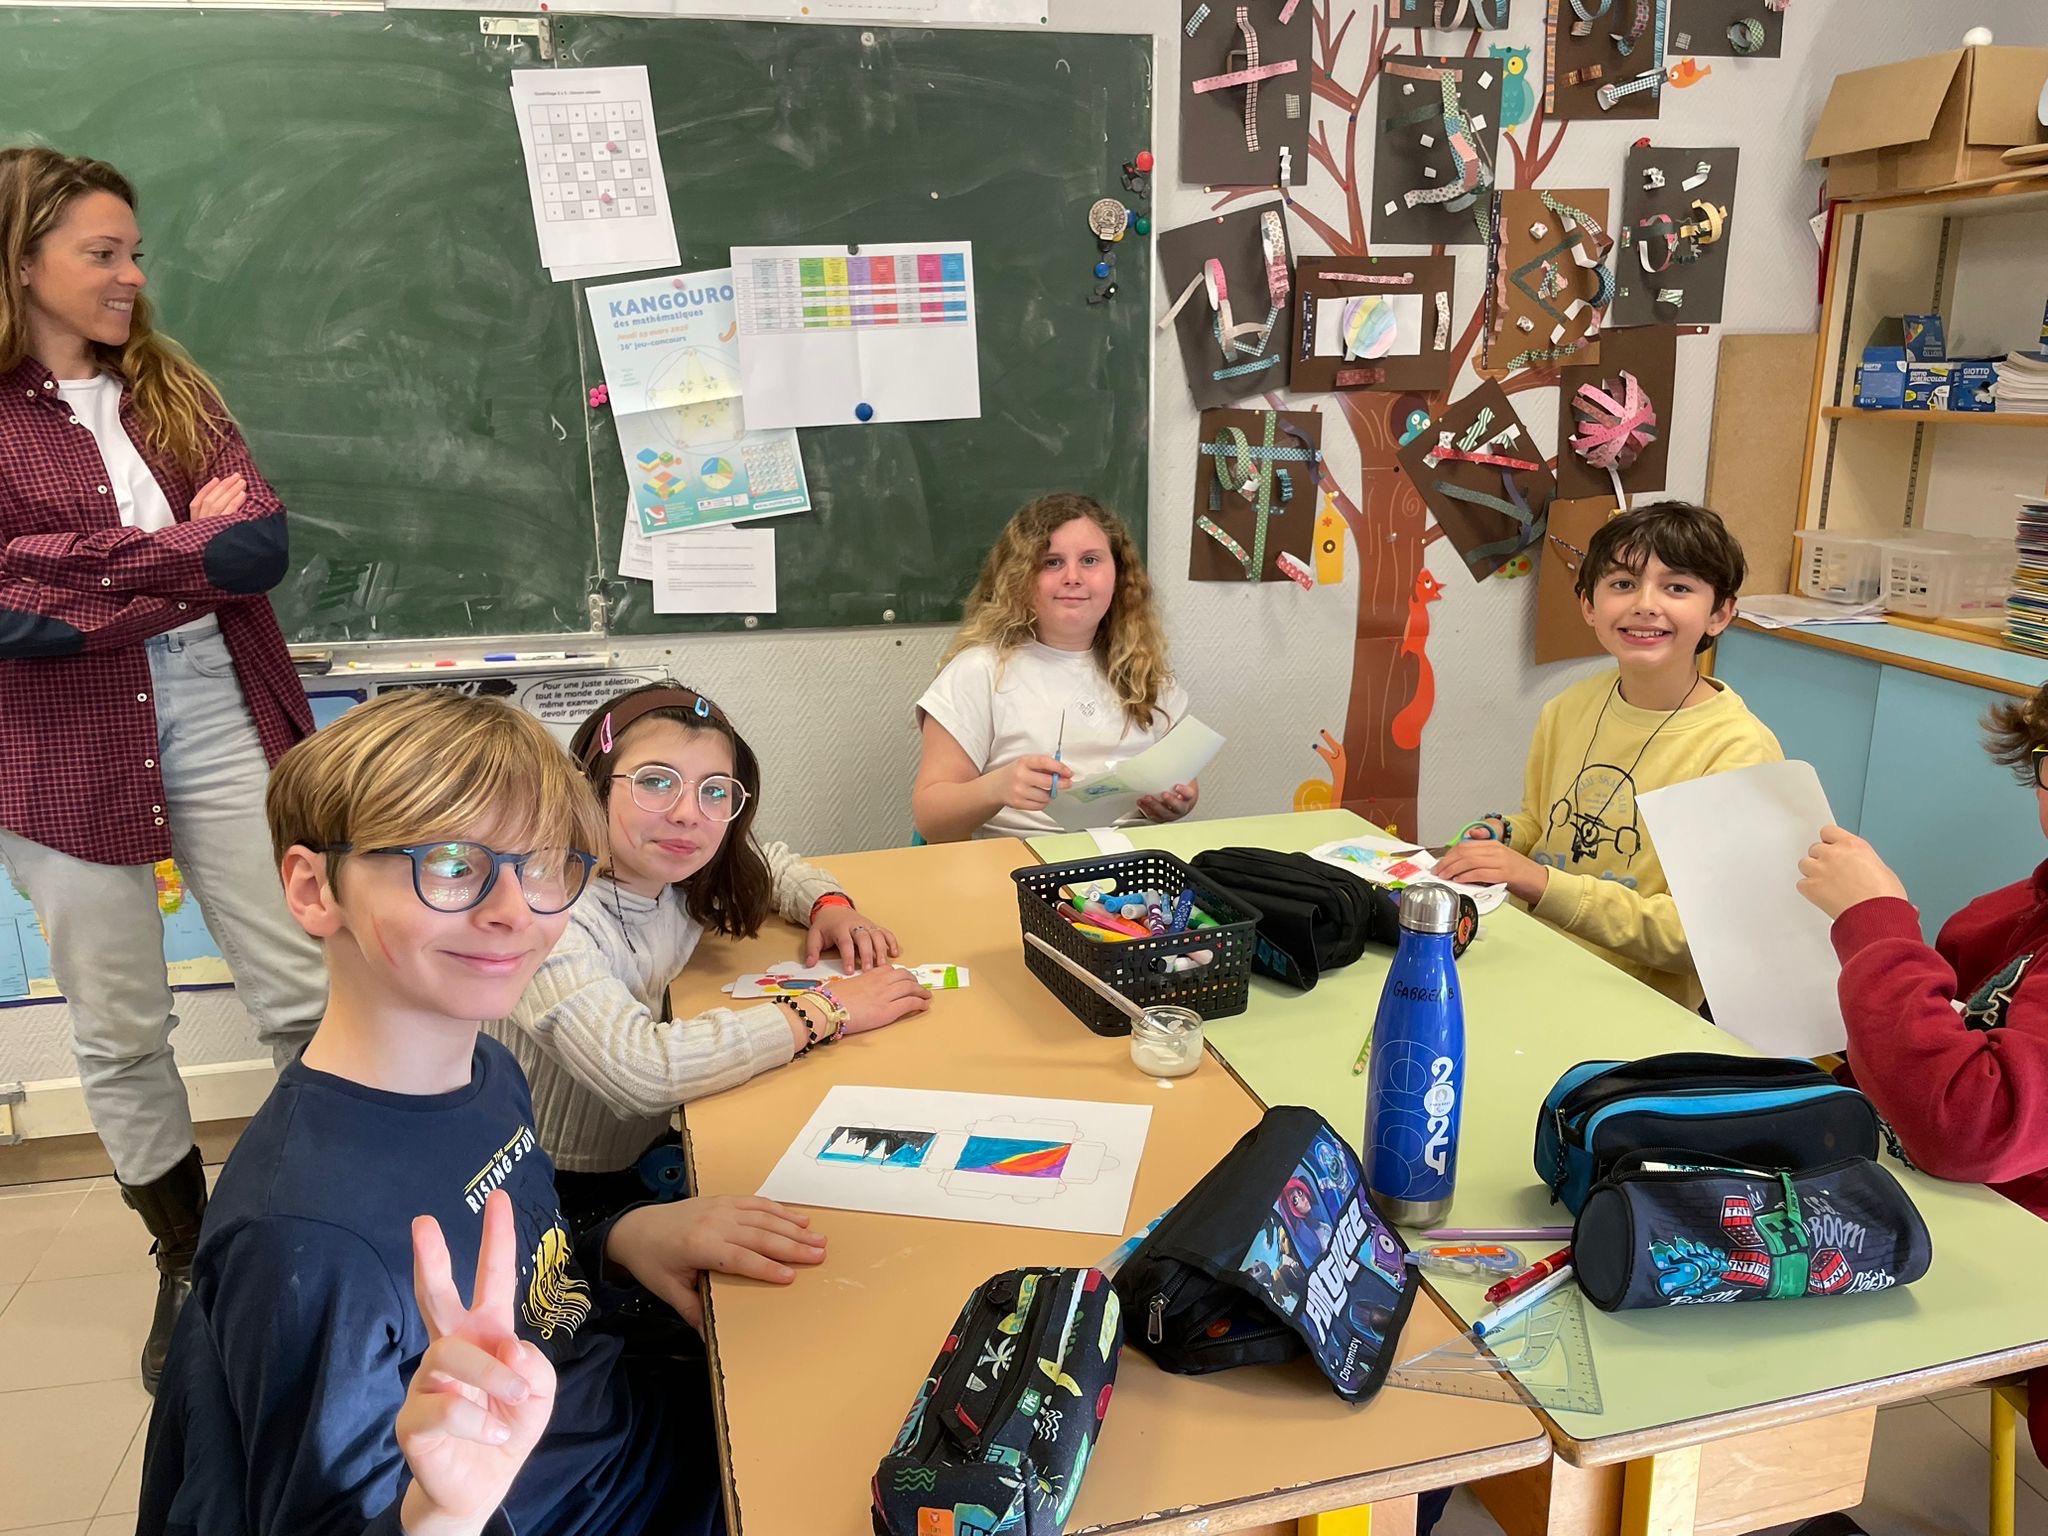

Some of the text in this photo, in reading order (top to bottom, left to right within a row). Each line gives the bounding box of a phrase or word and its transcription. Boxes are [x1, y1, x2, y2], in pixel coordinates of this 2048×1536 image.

[613, 308, 704, 329] des mathématiques
[1963, 367, 1990, 375] GIOTTO
[542, 682, 562, 690] Pour
[604, 677, 640, 686] sélection
[535, 692, 552, 700] tout
[564, 690, 592, 698] monde
[538, 701, 564, 709] même
[566, 699, 598, 707] examen
[541, 709, 566, 718] devoir
[465, 1154, 513, 1214] RISING
[1808, 1213, 1866, 1254] BOOM
[1305, 1198, 1369, 1346] FORTNITE
[1729, 1260, 1754, 1273] TNT
[1826, 1262, 1848, 1286] TNT
